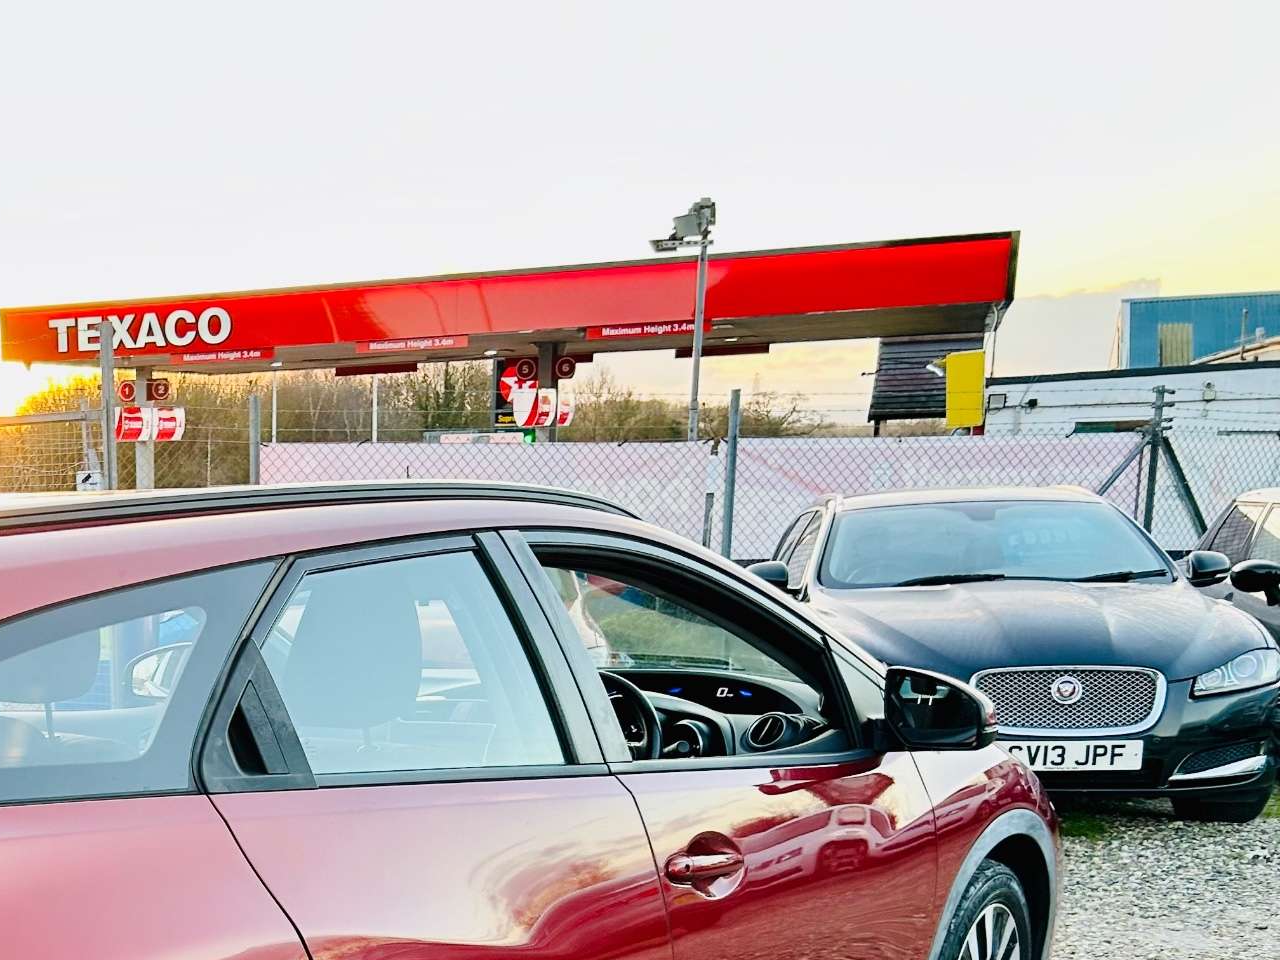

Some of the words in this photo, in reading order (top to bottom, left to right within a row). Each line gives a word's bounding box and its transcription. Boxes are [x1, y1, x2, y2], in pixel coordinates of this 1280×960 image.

[49, 307, 232, 353] TEXACO
[601, 325, 642, 336] Maximum
[643, 323, 671, 334] Height
[673, 322, 695, 332] 3.4m
[522, 365, 529, 374] 5
[562, 363, 570, 372] 6
[1008, 745, 1066, 766] V13
[1075, 745, 1126, 766] JPF
